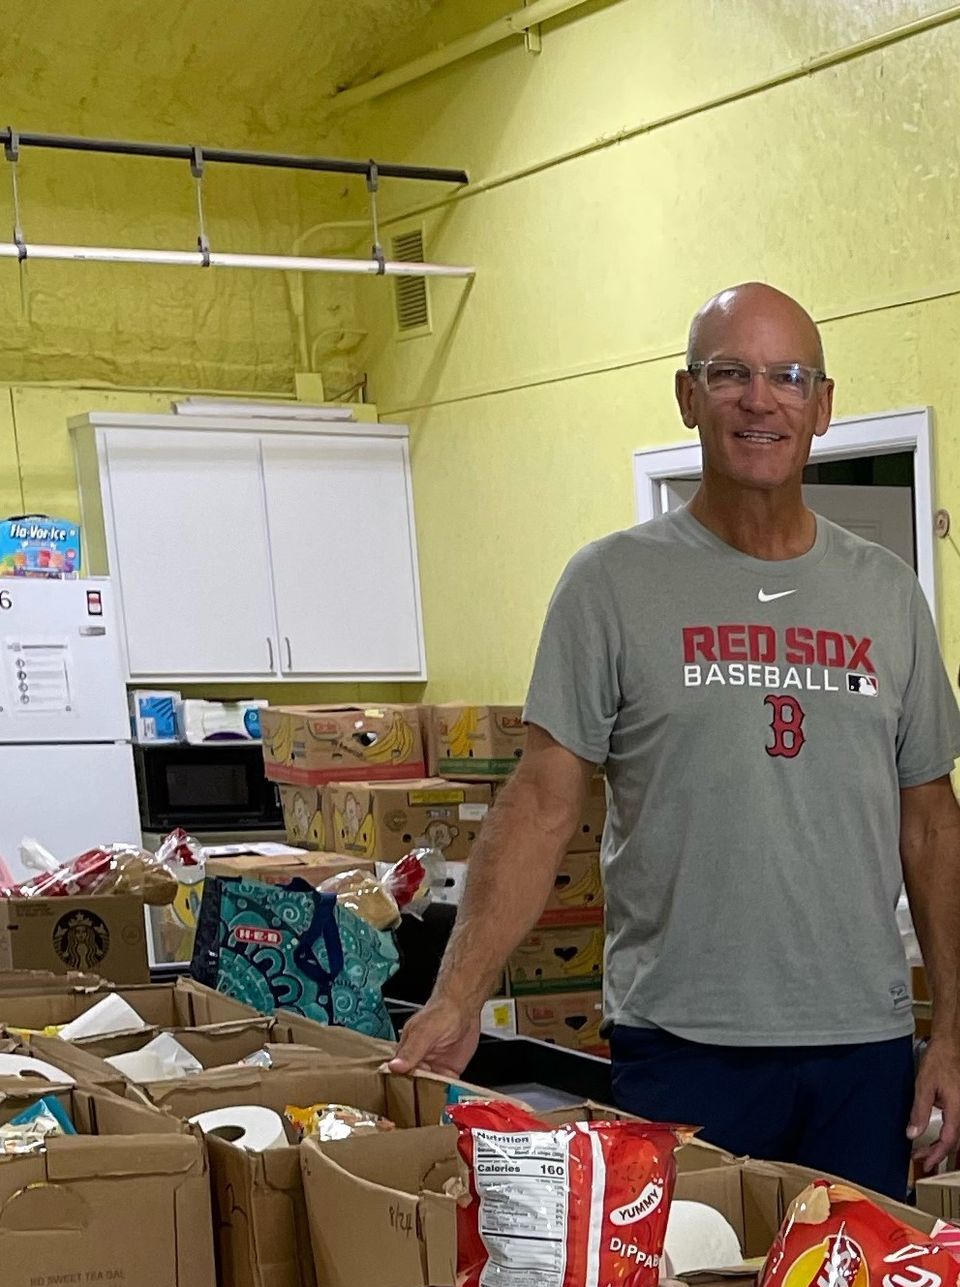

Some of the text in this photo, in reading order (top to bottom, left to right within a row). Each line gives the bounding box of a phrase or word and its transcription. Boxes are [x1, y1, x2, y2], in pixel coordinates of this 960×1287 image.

[682, 625, 876, 673] RED SOX
[684, 663, 839, 692] BASEBALL
[764, 694, 806, 759] B
[477, 1164, 564, 1175] Calories 160
[618, 1189, 660, 1221] YUMMY
[609, 1237, 660, 1269] DIPPAB
